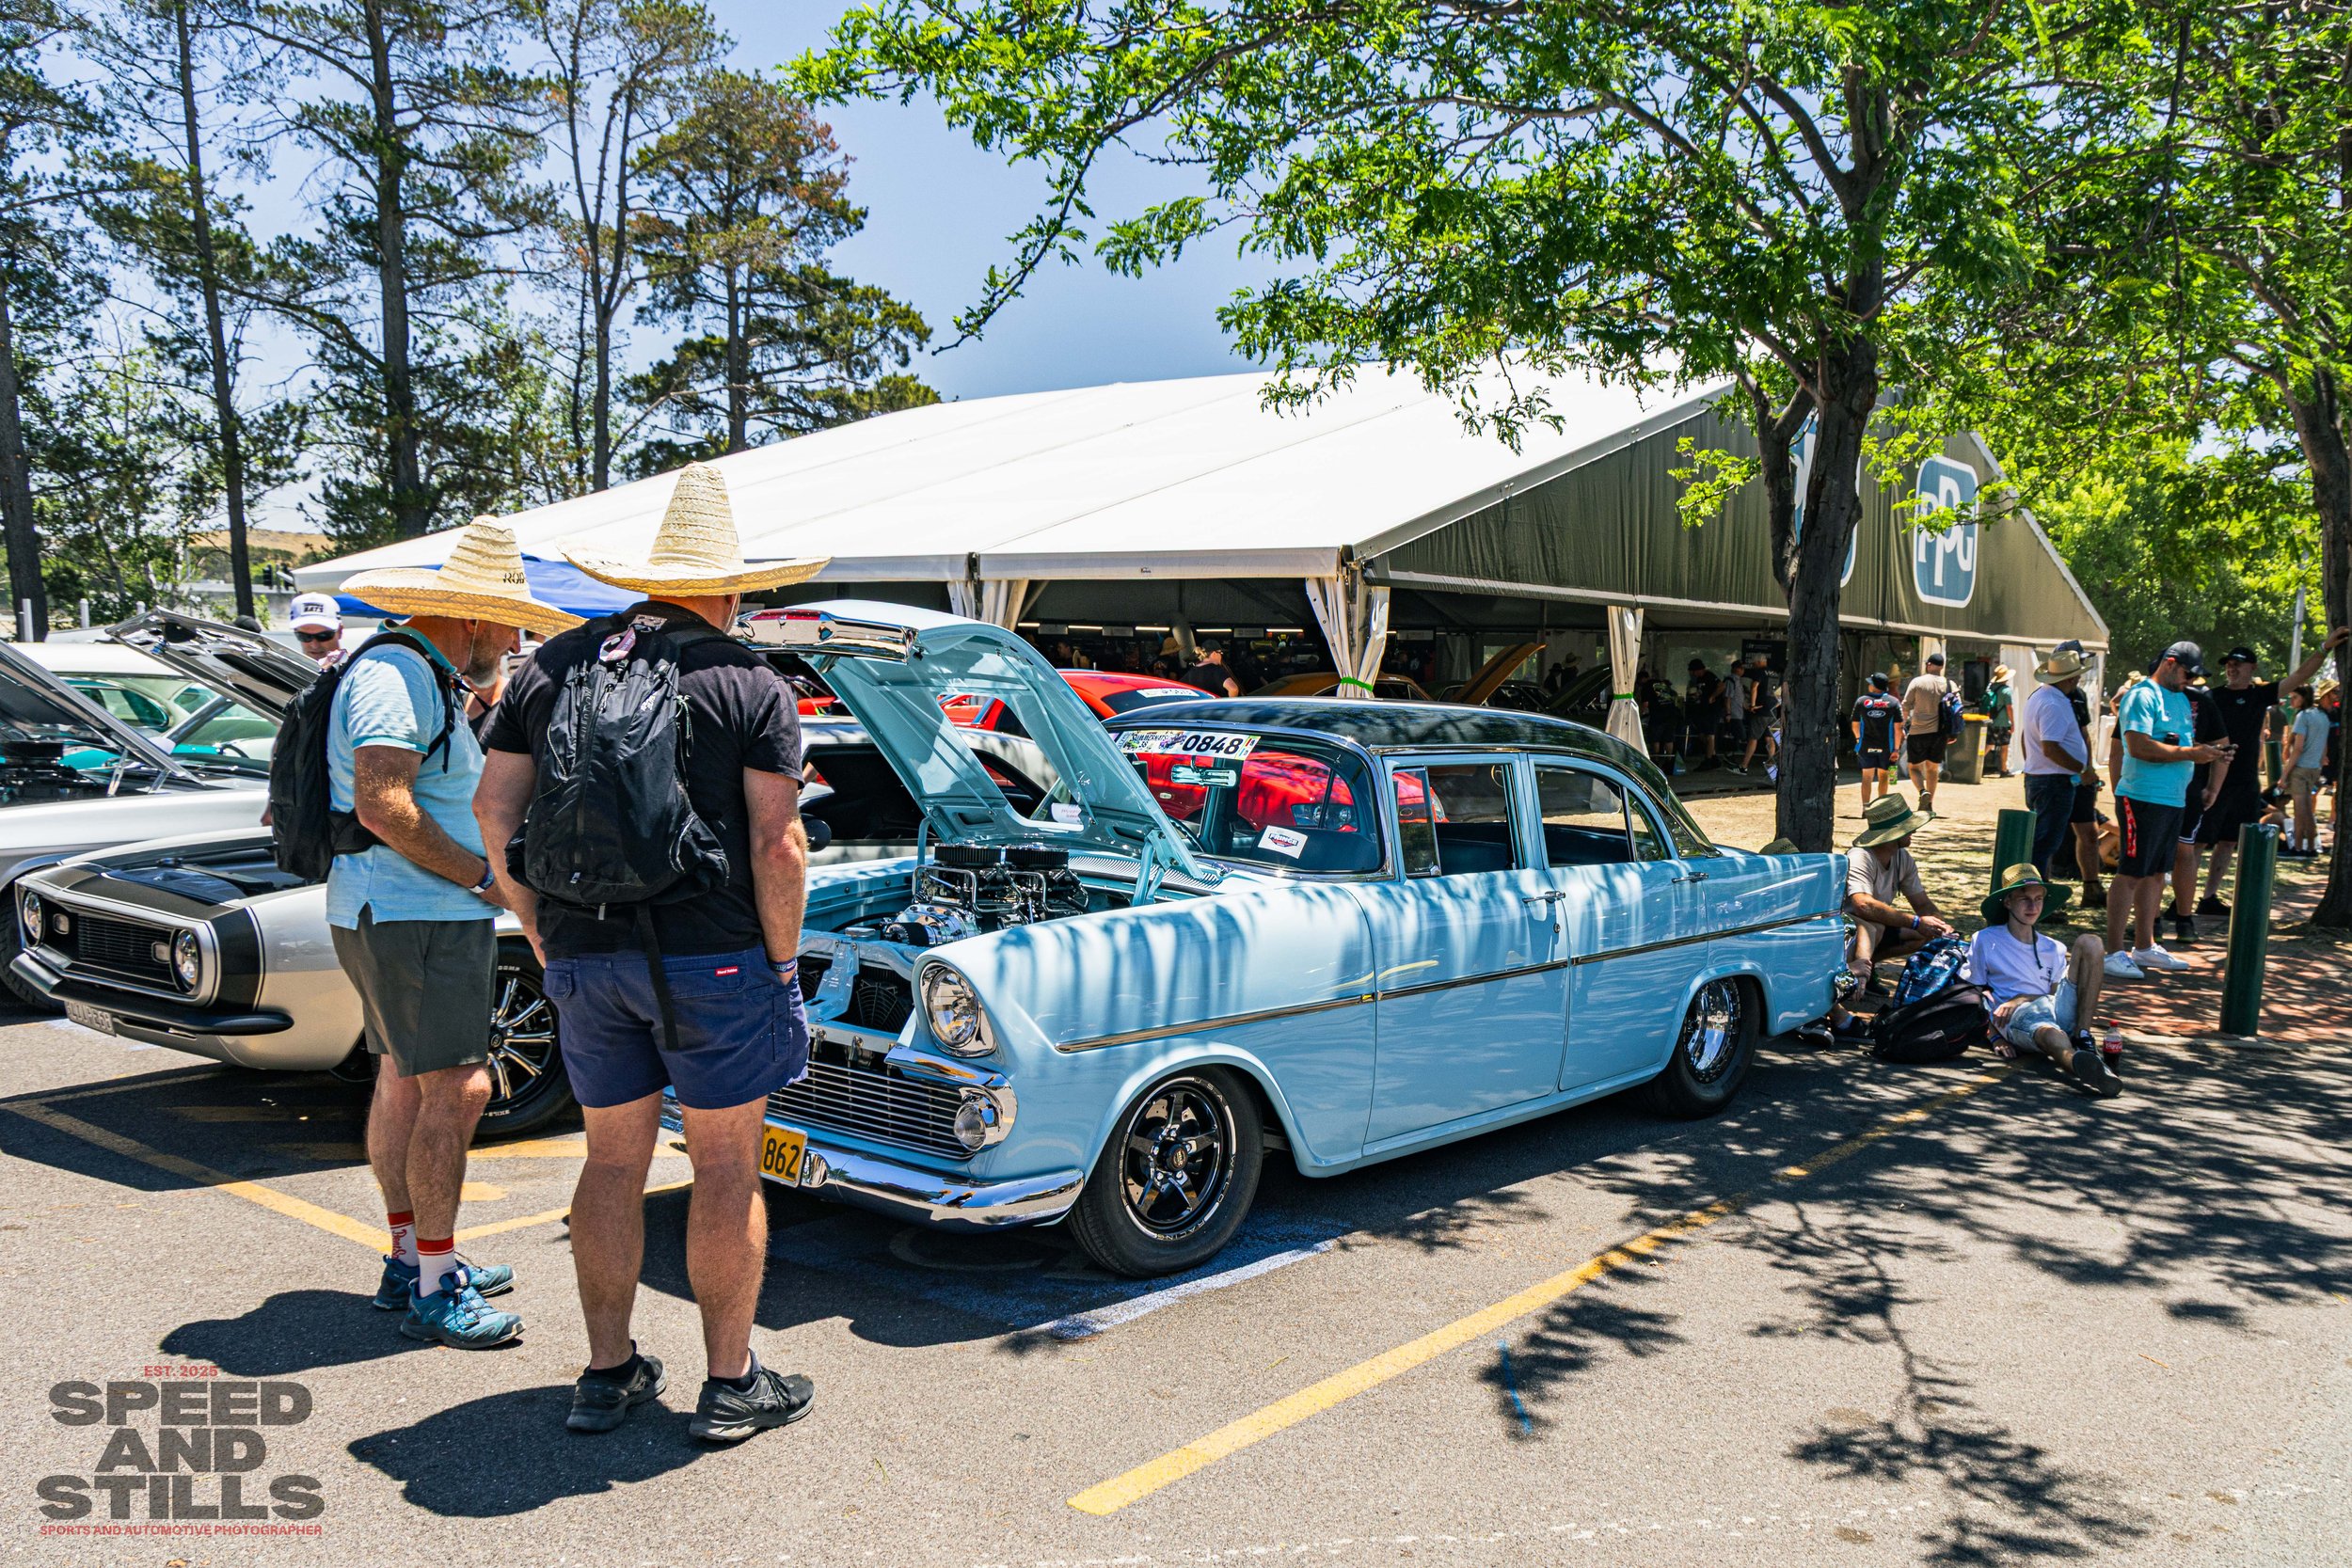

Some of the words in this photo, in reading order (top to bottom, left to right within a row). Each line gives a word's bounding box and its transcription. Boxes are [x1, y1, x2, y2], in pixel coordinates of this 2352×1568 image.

[1918, 475, 1974, 587] PPG
[1182, 735, 1244, 754] 0848
[764, 1137, 800, 1179] 862
[1156, 1220, 1206, 1242] RACING
